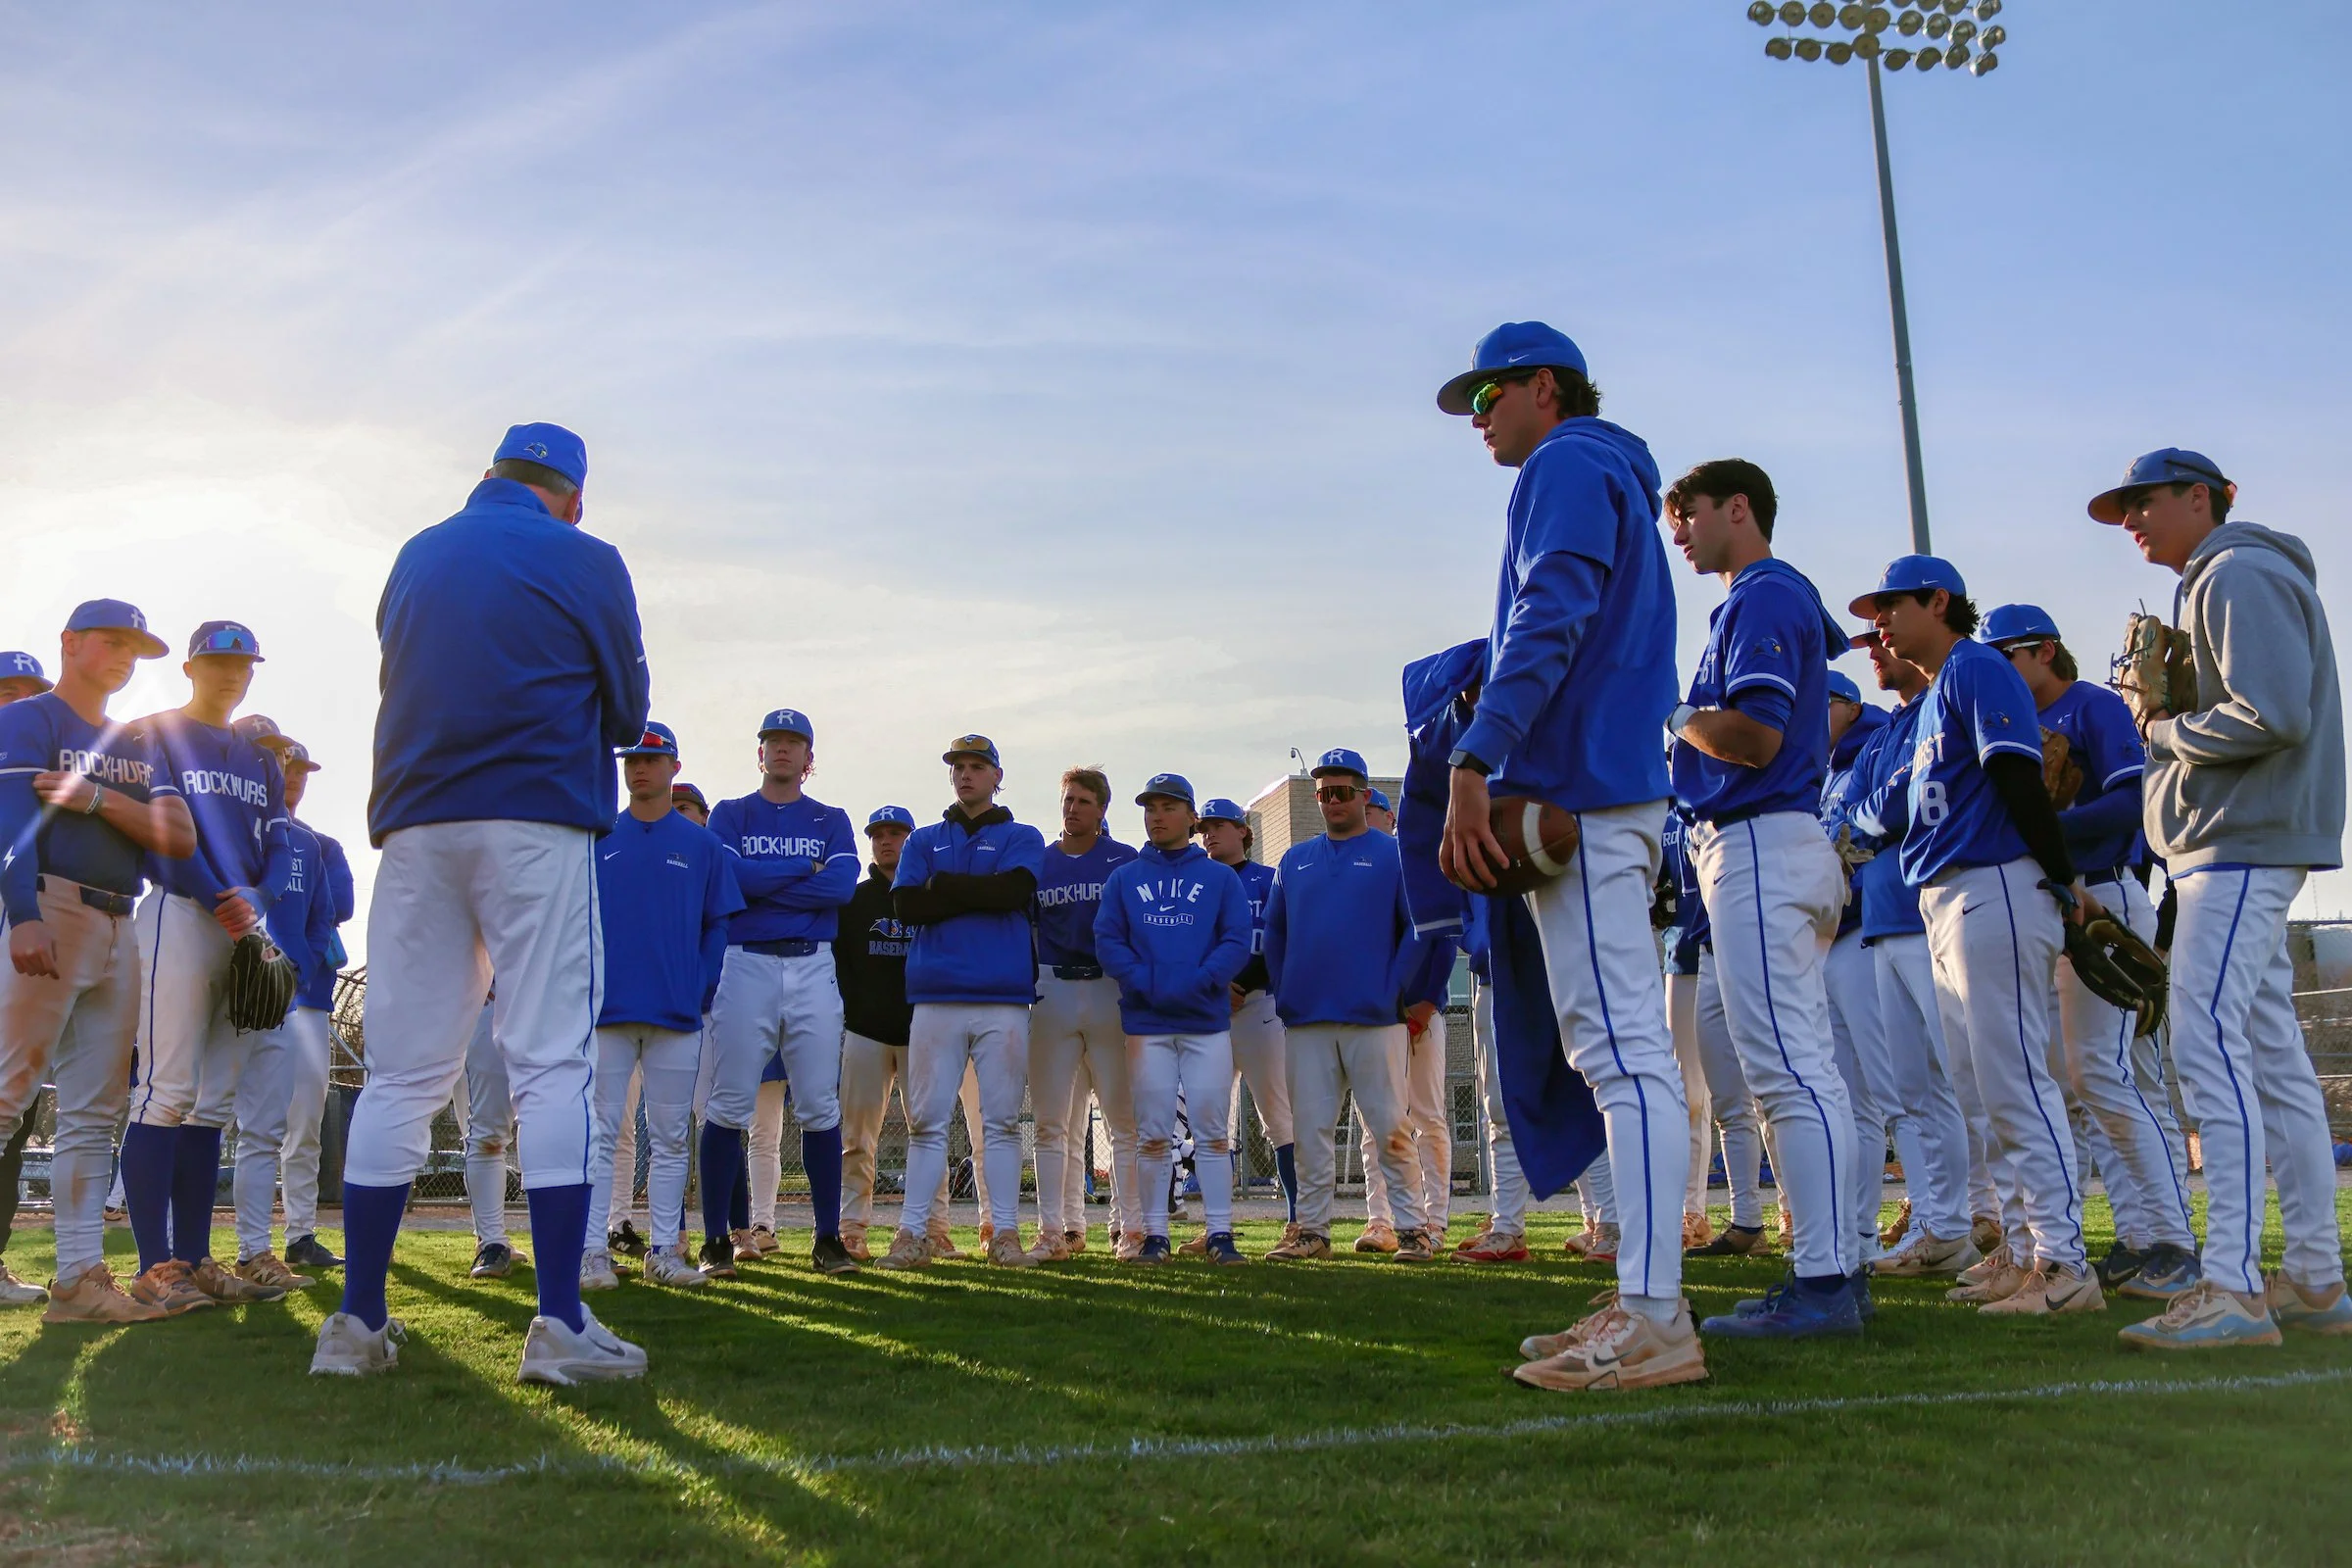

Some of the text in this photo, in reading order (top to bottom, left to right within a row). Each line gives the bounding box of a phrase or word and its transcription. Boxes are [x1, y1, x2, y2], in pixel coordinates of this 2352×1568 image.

[14, 653, 35, 673] R
[777, 710, 794, 724] R
[1328, 750, 1345, 763] R
[1201, 802, 1216, 816] R
[1919, 781, 1949, 826] 8
[880, 808, 895, 820] R
[1037, 882, 1105, 907] ROCKHUR
[1136, 878, 1204, 904] NIKE
